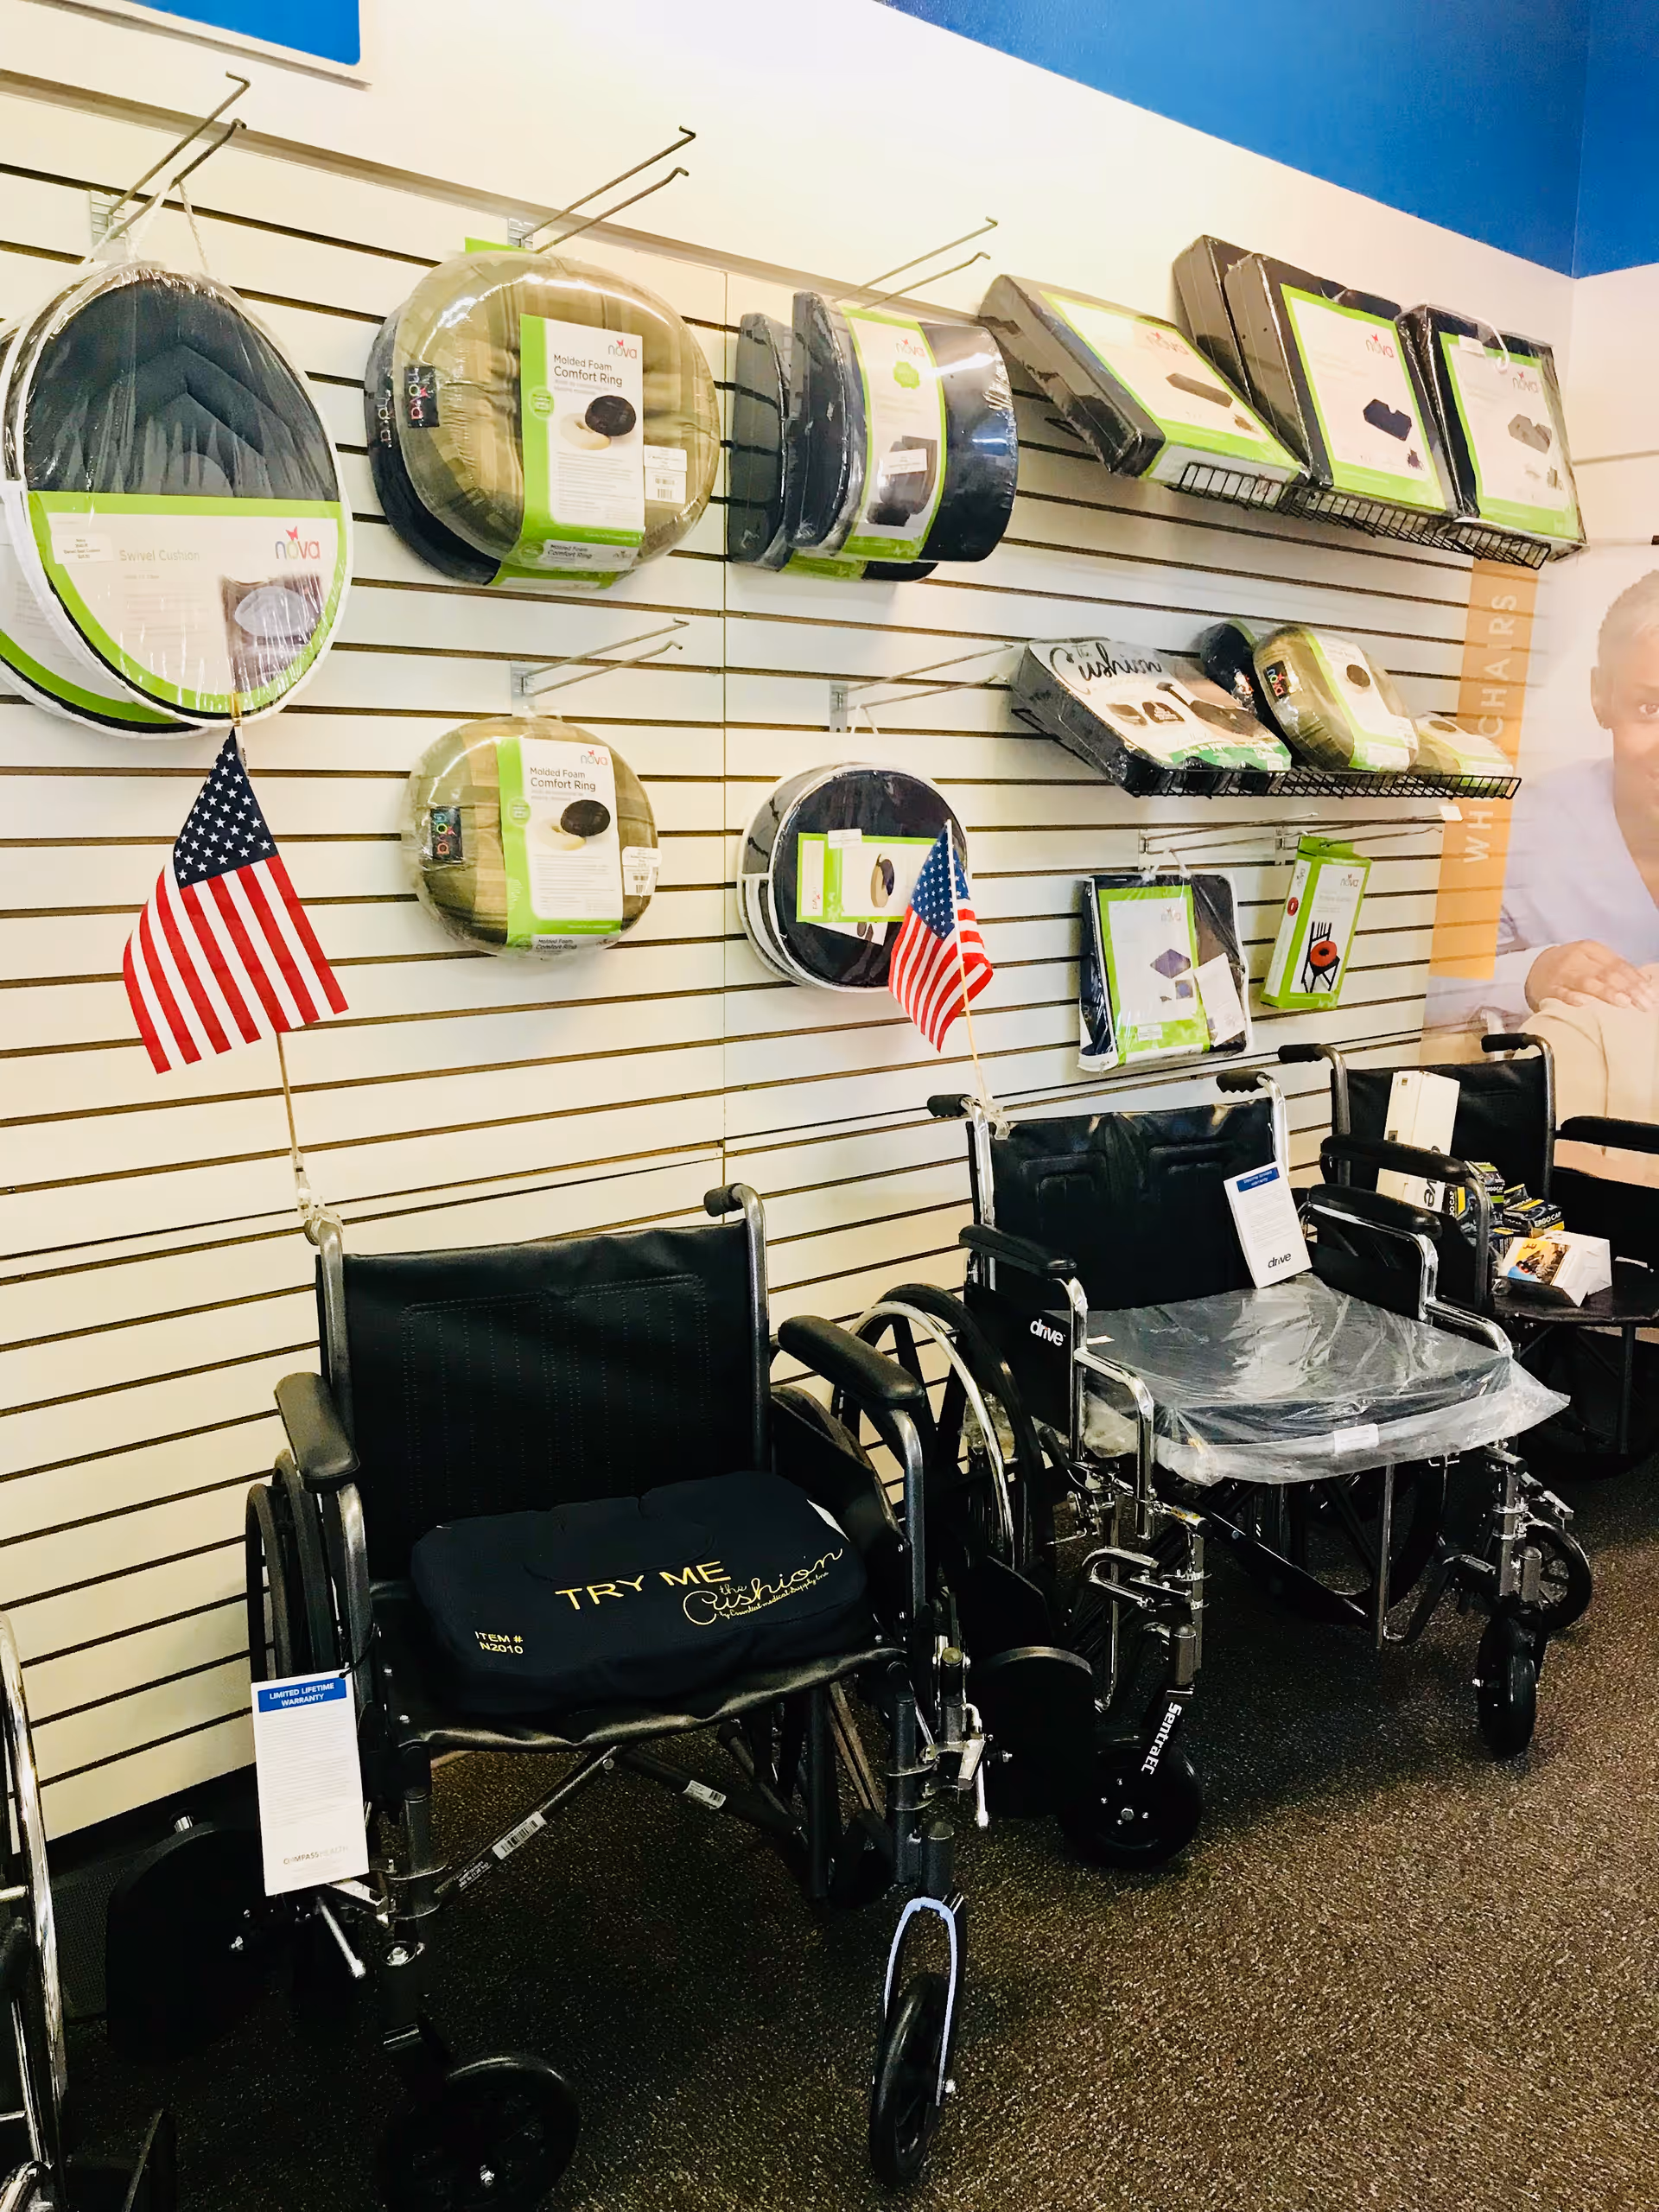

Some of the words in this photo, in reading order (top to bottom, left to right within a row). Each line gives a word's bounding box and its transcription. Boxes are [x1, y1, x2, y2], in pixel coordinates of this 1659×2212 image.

[607, 344, 638, 359] nova
[1365, 338, 1395, 359] nova
[554, 353, 586, 367] Molded
[588, 359, 612, 372] Foam
[554, 365, 597, 382] Comfort
[600, 372, 623, 388] Ring
[1512, 376, 1539, 394] nova
[118, 550, 156, 562] Swivel
[158, 550, 200, 562] Cushion
[275, 539, 321, 559] nova
[1050, 641, 1163, 695] Cushion
[1464, 593, 1517, 864] WHCHAIRS
[580, 753, 608, 766] nova
[530, 766, 561, 777] Molded
[563, 769, 586, 779] Foam
[531, 777, 572, 789] Comfort
[574, 779, 596, 792] Ring
[1340, 877, 1359, 888] nova
[1551, 1211, 1562, 1222] CAP
[1268, 1253, 1292, 1268] drive
[1029, 1318, 1064, 1347] drive
[555, 1574, 645, 1611] TRY
[658, 1560, 732, 1588] ME
[683, 1548, 843, 1625] Cushion
[719, 1583, 747, 1595] the
[474, 1630, 511, 1643] ITEM
[513, 1634, 524, 1643] #
[480, 1641, 524, 1655] N2010
[269, 1689, 300, 1700] LIMITED
[301, 1682, 335, 1694] LIFETIME
[281, 1693, 325, 1707] WARRANTY
[1141, 1701, 1183, 1776] SentraEC
